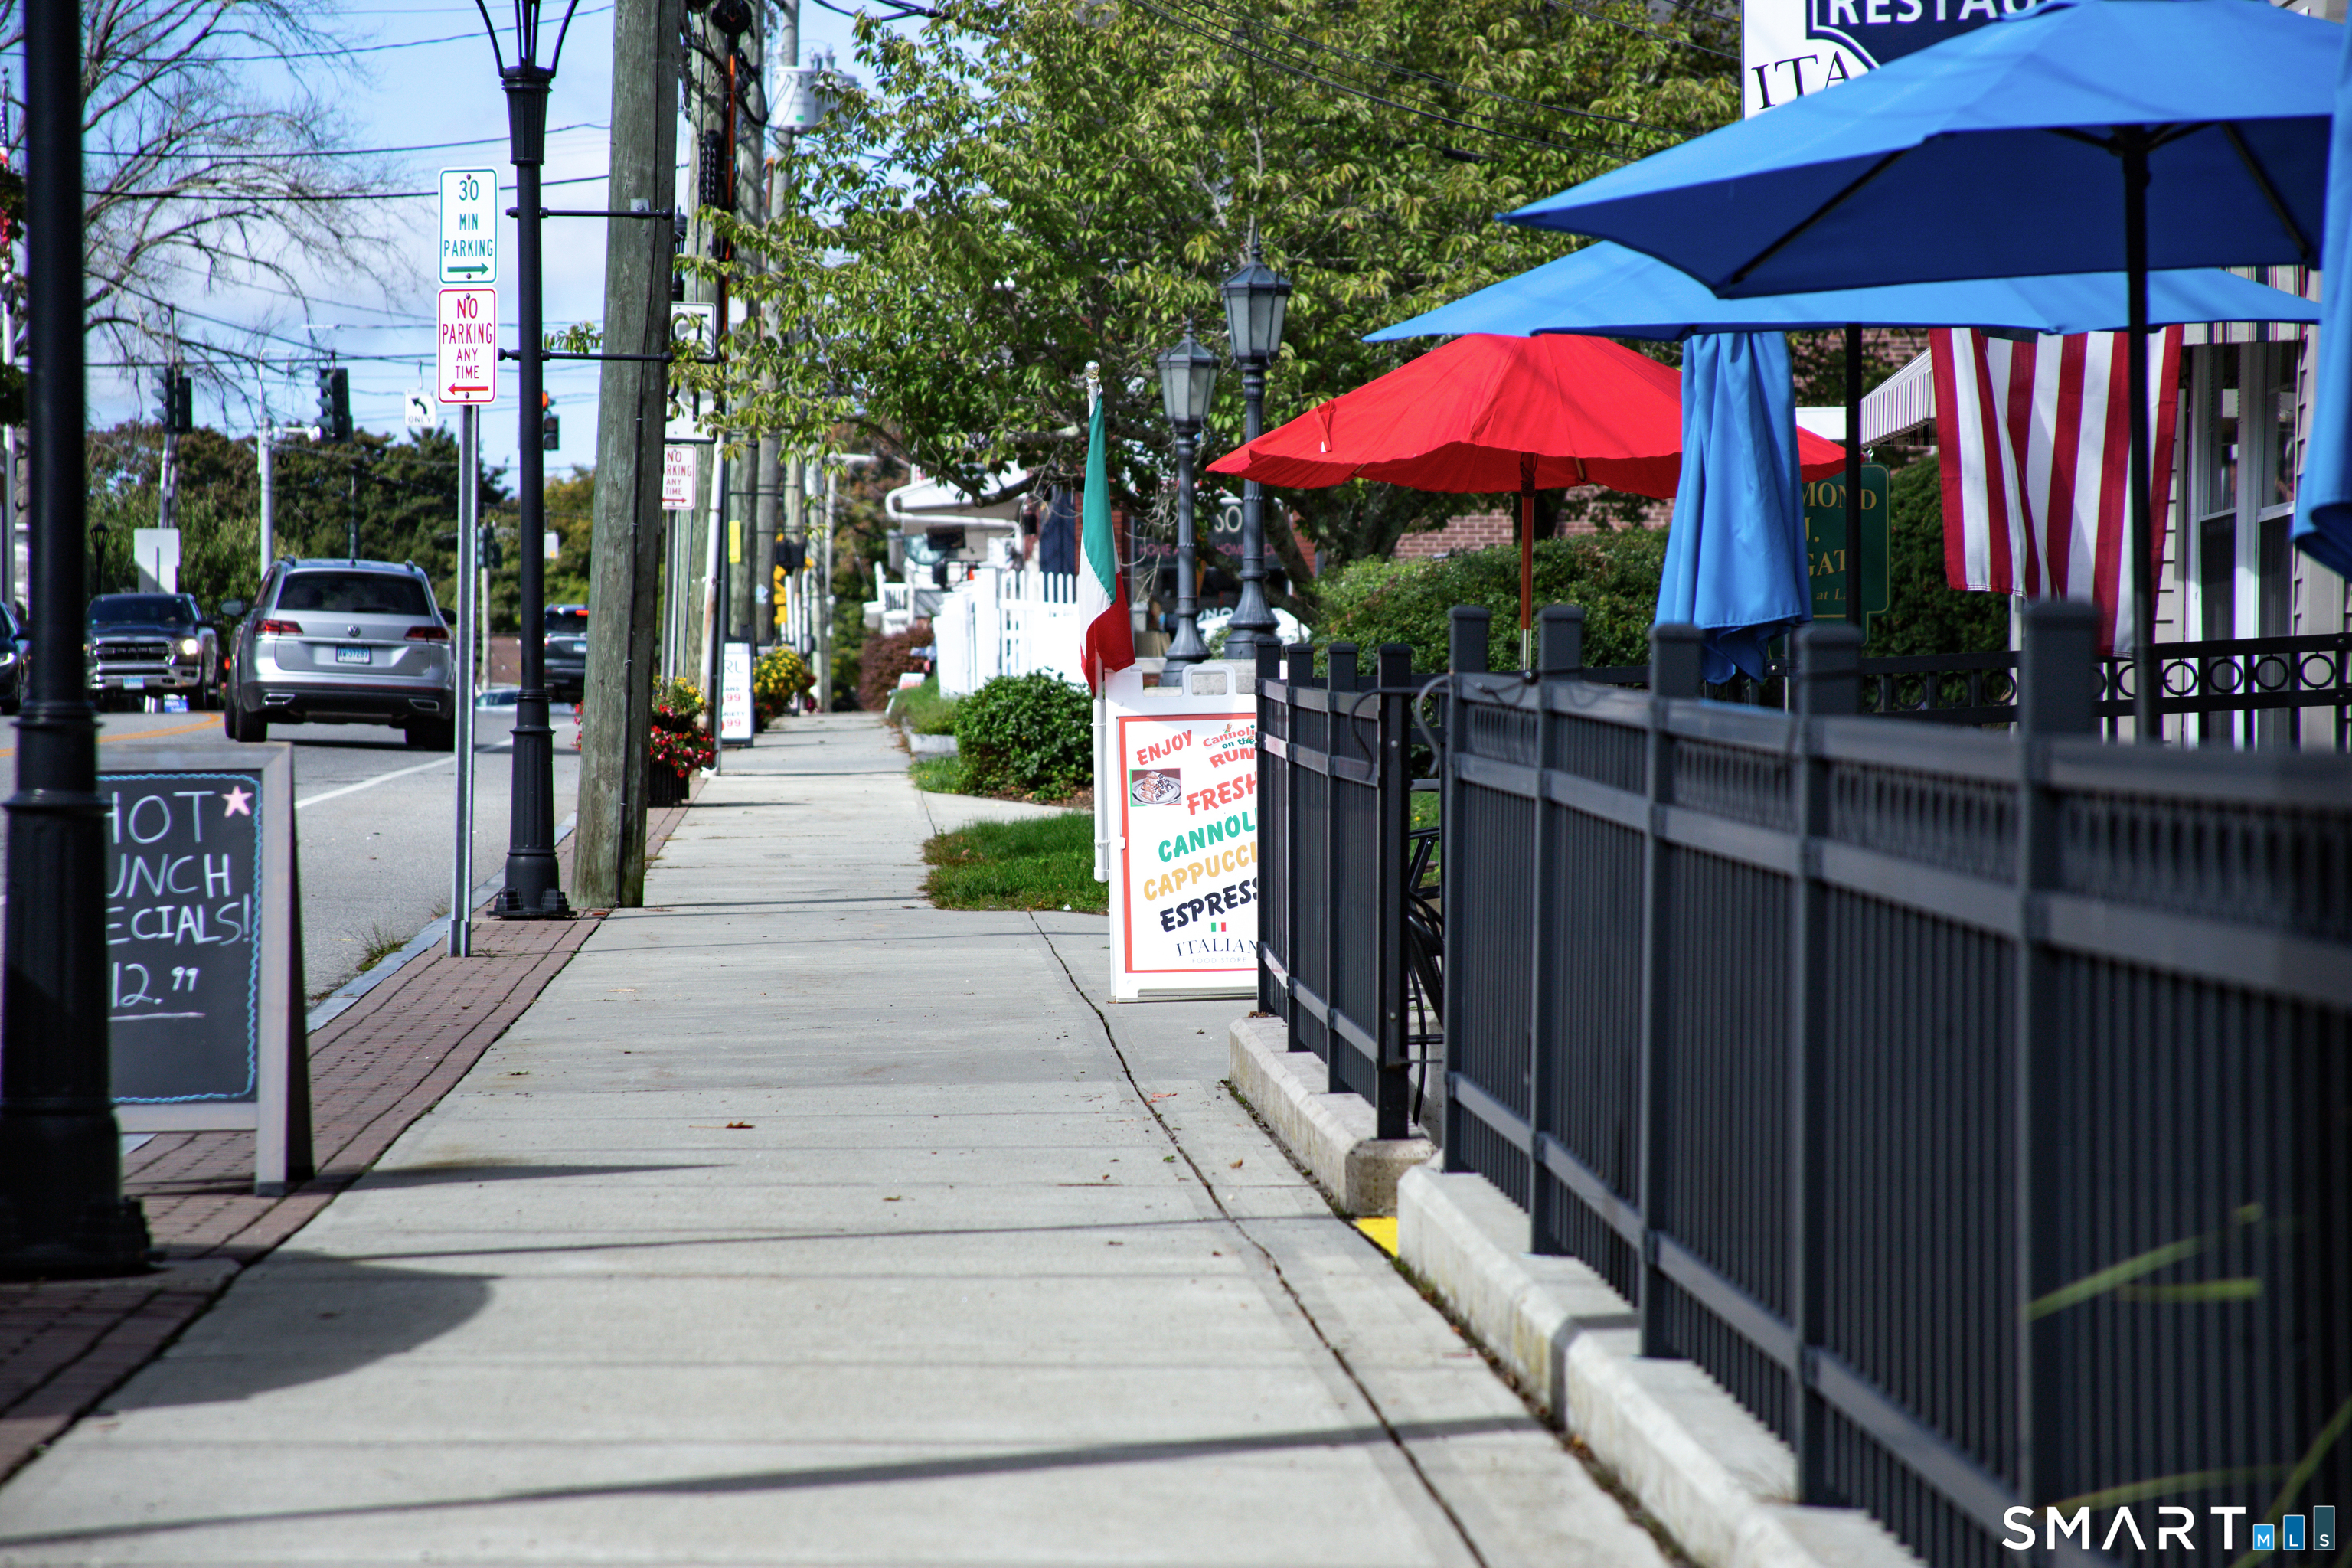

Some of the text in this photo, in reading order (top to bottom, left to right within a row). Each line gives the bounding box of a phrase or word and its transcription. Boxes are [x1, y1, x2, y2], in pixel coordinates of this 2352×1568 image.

[1751, 51, 1851, 109] ITA
[459, 179, 479, 201] 30
[459, 213, 479, 230] MIN
[444, 239, 494, 257] PARKING
[457, 298, 478, 318] NO
[443, 322, 492, 345] PARKING
[671, 312, 708, 345] CT
[456, 348, 479, 361] ANY
[455, 365, 479, 379] TIME
[408, 415, 432, 423] ONLY
[667, 451, 682, 462] NO
[664, 464, 692, 476] RKING
[665, 487, 683, 495] TIME
[1816, 591, 1828, 600] at
[724, 660, 745, 673] RL
[1203, 724, 1255, 747] Cannoli
[1237, 737, 1255, 746] the
[1136, 730, 1192, 766] ENJOY
[1209, 748, 1256, 768] RUN
[1187, 770, 1256, 815] FRESH
[106, 853, 230, 898] UNCH
[1144, 841, 1257, 901] CAPPUCCI
[1160, 877, 1257, 932] ESPRES
[106, 893, 250, 946] ECIALS!
[1176, 938, 1257, 957] ITALIAN
